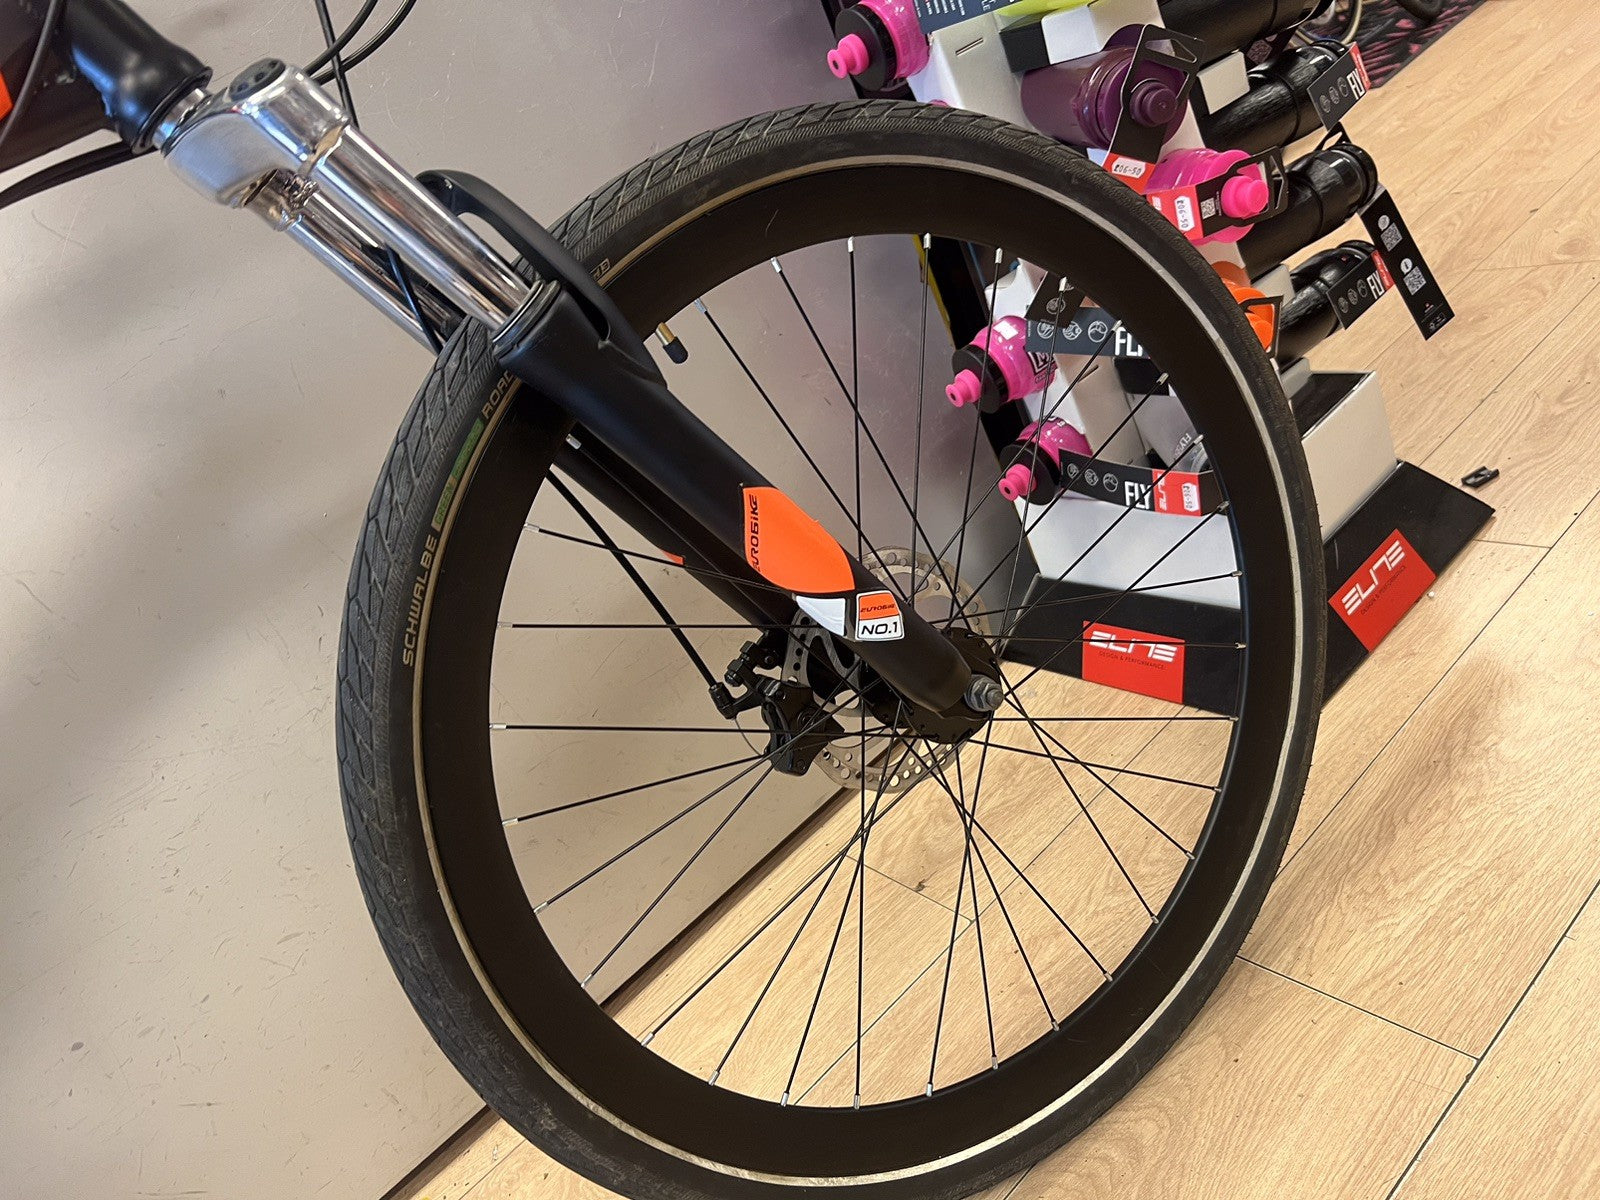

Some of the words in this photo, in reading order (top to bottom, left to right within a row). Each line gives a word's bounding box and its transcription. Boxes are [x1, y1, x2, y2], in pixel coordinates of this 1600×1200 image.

[1124, 480, 1152, 510] FLY
[402, 534, 438, 667] SCHWALBE
[861, 621, 898, 635] NO.1
